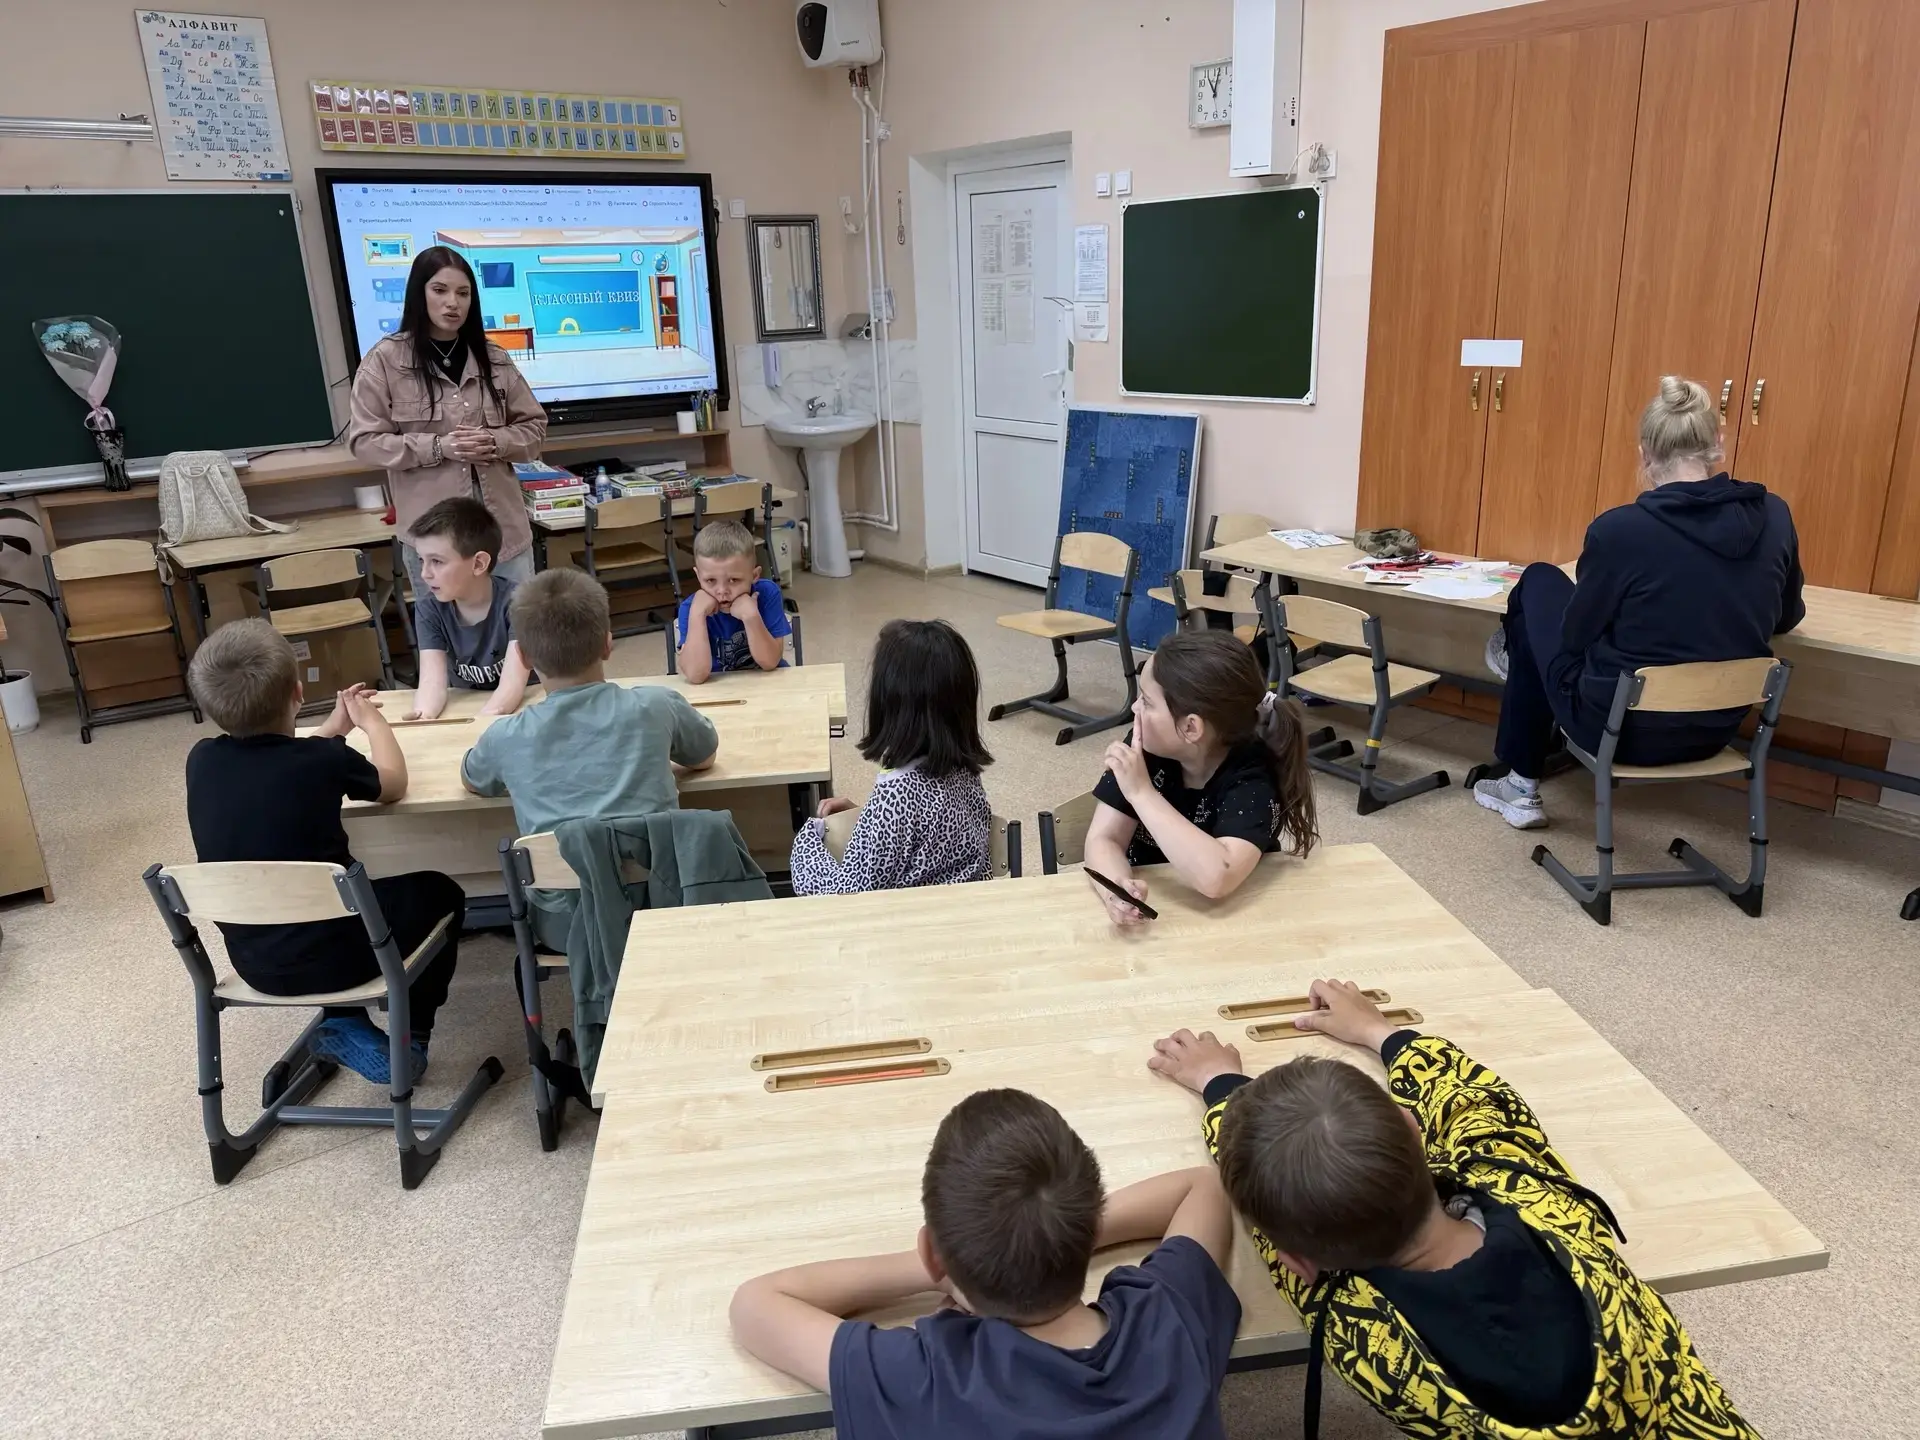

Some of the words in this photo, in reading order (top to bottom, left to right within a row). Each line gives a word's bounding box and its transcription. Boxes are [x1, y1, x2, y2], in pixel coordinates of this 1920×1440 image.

[168, 19, 238, 32] АЛФАВИТ
[165, 39, 180, 47] Аа
[191, 39, 205, 49] Бб
[218, 41, 230, 50] Вв
[170, 56, 182, 70] Дд
[199, 57, 208, 67] Ее
[1226, 67, 1228, 75] 1
[199, 75, 212, 84] Ии
[1199, 79, 1205, 88] 10
[196, 92, 215, 100] Мм
[226, 93, 240, 102] Нн
[253, 93, 263, 102] Оо
[1198, 92, 1203, 100] 9
[434, 99, 445, 111] М
[454, 99, 461, 111] Л
[471, 101, 478, 112] Р
[488, 99, 497, 114] Й
[507, 102, 514, 114] Б
[524, 103, 531, 115] В
[541, 103, 547, 115] Г
[559, 105, 567, 118] Д
[574, 106, 583, 117] Ж
[592, 106, 598, 118] З
[668, 110, 676, 121] Ъ
[1198, 104, 1202, 112] 8
[179, 108, 193, 117] Пп
[206, 109, 218, 120] Рр
[233, 110, 242, 118] Сс
[1204, 112, 1208, 120] 7
[1213, 111, 1218, 119] 6
[1222, 110, 1227, 118] 5
[185, 125, 195, 137] Уу
[208, 125, 221, 138] Фф
[232, 126, 246, 135] Хх
[512, 131, 520, 143] П
[529, 132, 537, 143] Ф
[545, 132, 553, 144] К
[562, 133, 568, 144] Т
[576, 133, 586, 145] Ш
[595, 134, 603, 145] С
[611, 135, 618, 146] Х
[626, 135, 633, 146] Ц
[643, 136, 650, 146] Ч
[656, 135, 667, 148] Щ
[672, 137, 679, 147] Ь
[187, 142, 200, 151] Чч
[206, 142, 225, 151] Шш
[237, 160, 251, 168] Юю
[263, 160, 275, 169] Яя
[534, 290, 603, 306] КЛАССНЫЙ
[608, 291, 640, 303] КВИЗ
